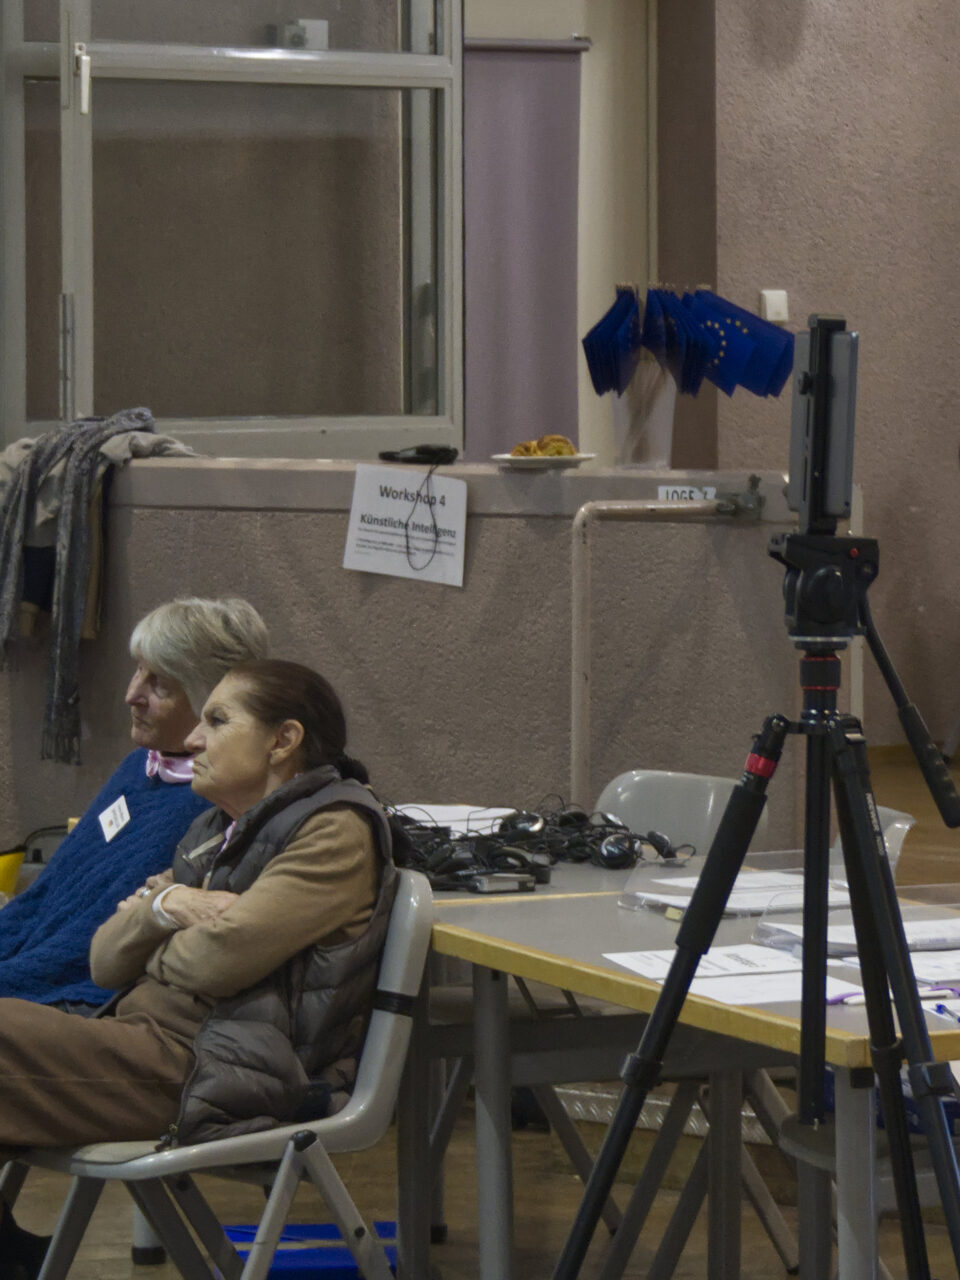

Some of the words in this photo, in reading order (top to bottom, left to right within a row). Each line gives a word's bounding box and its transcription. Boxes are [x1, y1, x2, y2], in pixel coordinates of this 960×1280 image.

[379, 484, 437, 507] Workshop
[439, 494, 446, 507] 4
[411, 521, 457, 539] Intellgenz
